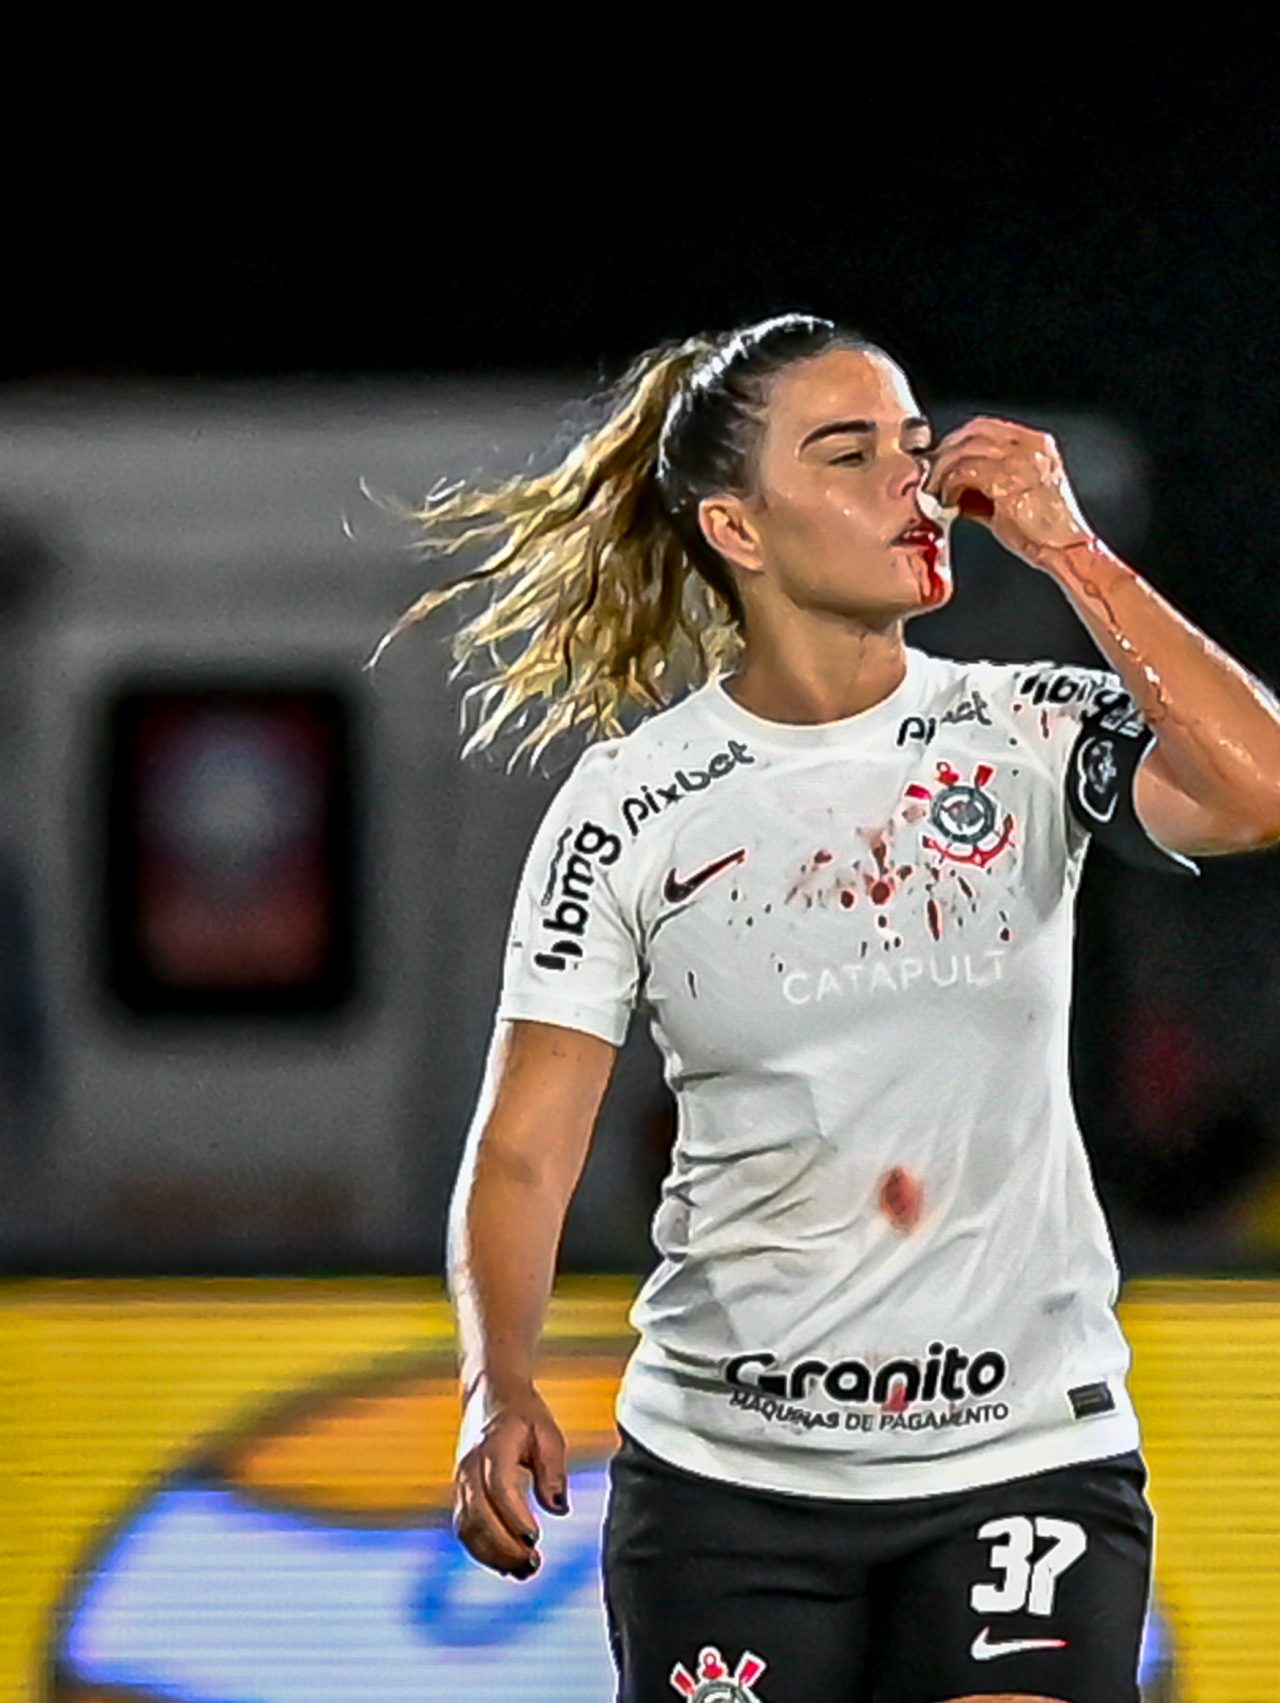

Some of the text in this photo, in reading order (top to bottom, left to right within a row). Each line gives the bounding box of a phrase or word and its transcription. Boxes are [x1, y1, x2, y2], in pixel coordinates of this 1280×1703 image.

[622, 740, 755, 837] pixbet
[543, 820, 622, 936] bmg
[782, 950, 1007, 1005] CATAPULT
[725, 1341, 1006, 1403] Granito
[845, 1412, 874, 1432] DE
[970, 1515, 1088, 1616] 37
